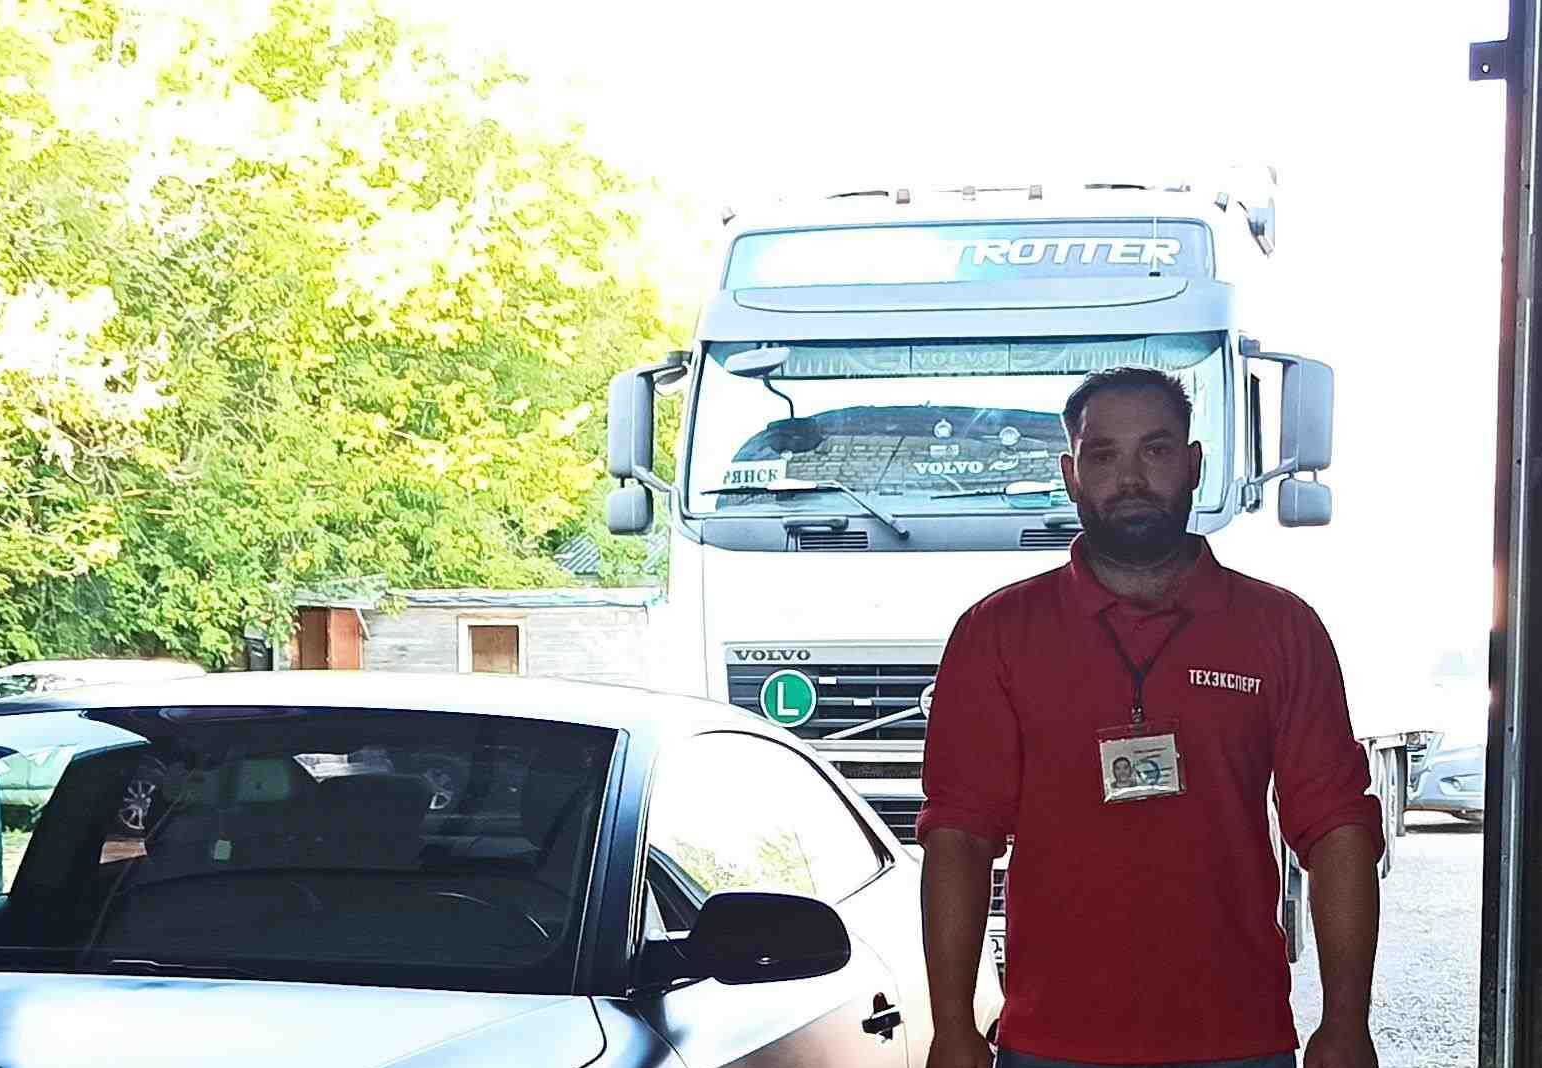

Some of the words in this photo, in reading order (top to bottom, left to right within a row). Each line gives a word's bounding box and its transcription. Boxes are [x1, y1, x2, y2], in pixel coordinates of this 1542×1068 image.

[913, 461, 984, 475] VOLVO
[733, 649, 811, 661] VOLVO
[1188, 669, 1261, 695] ТЕХЭКСПЕРТ
[777, 681, 799, 716] L
